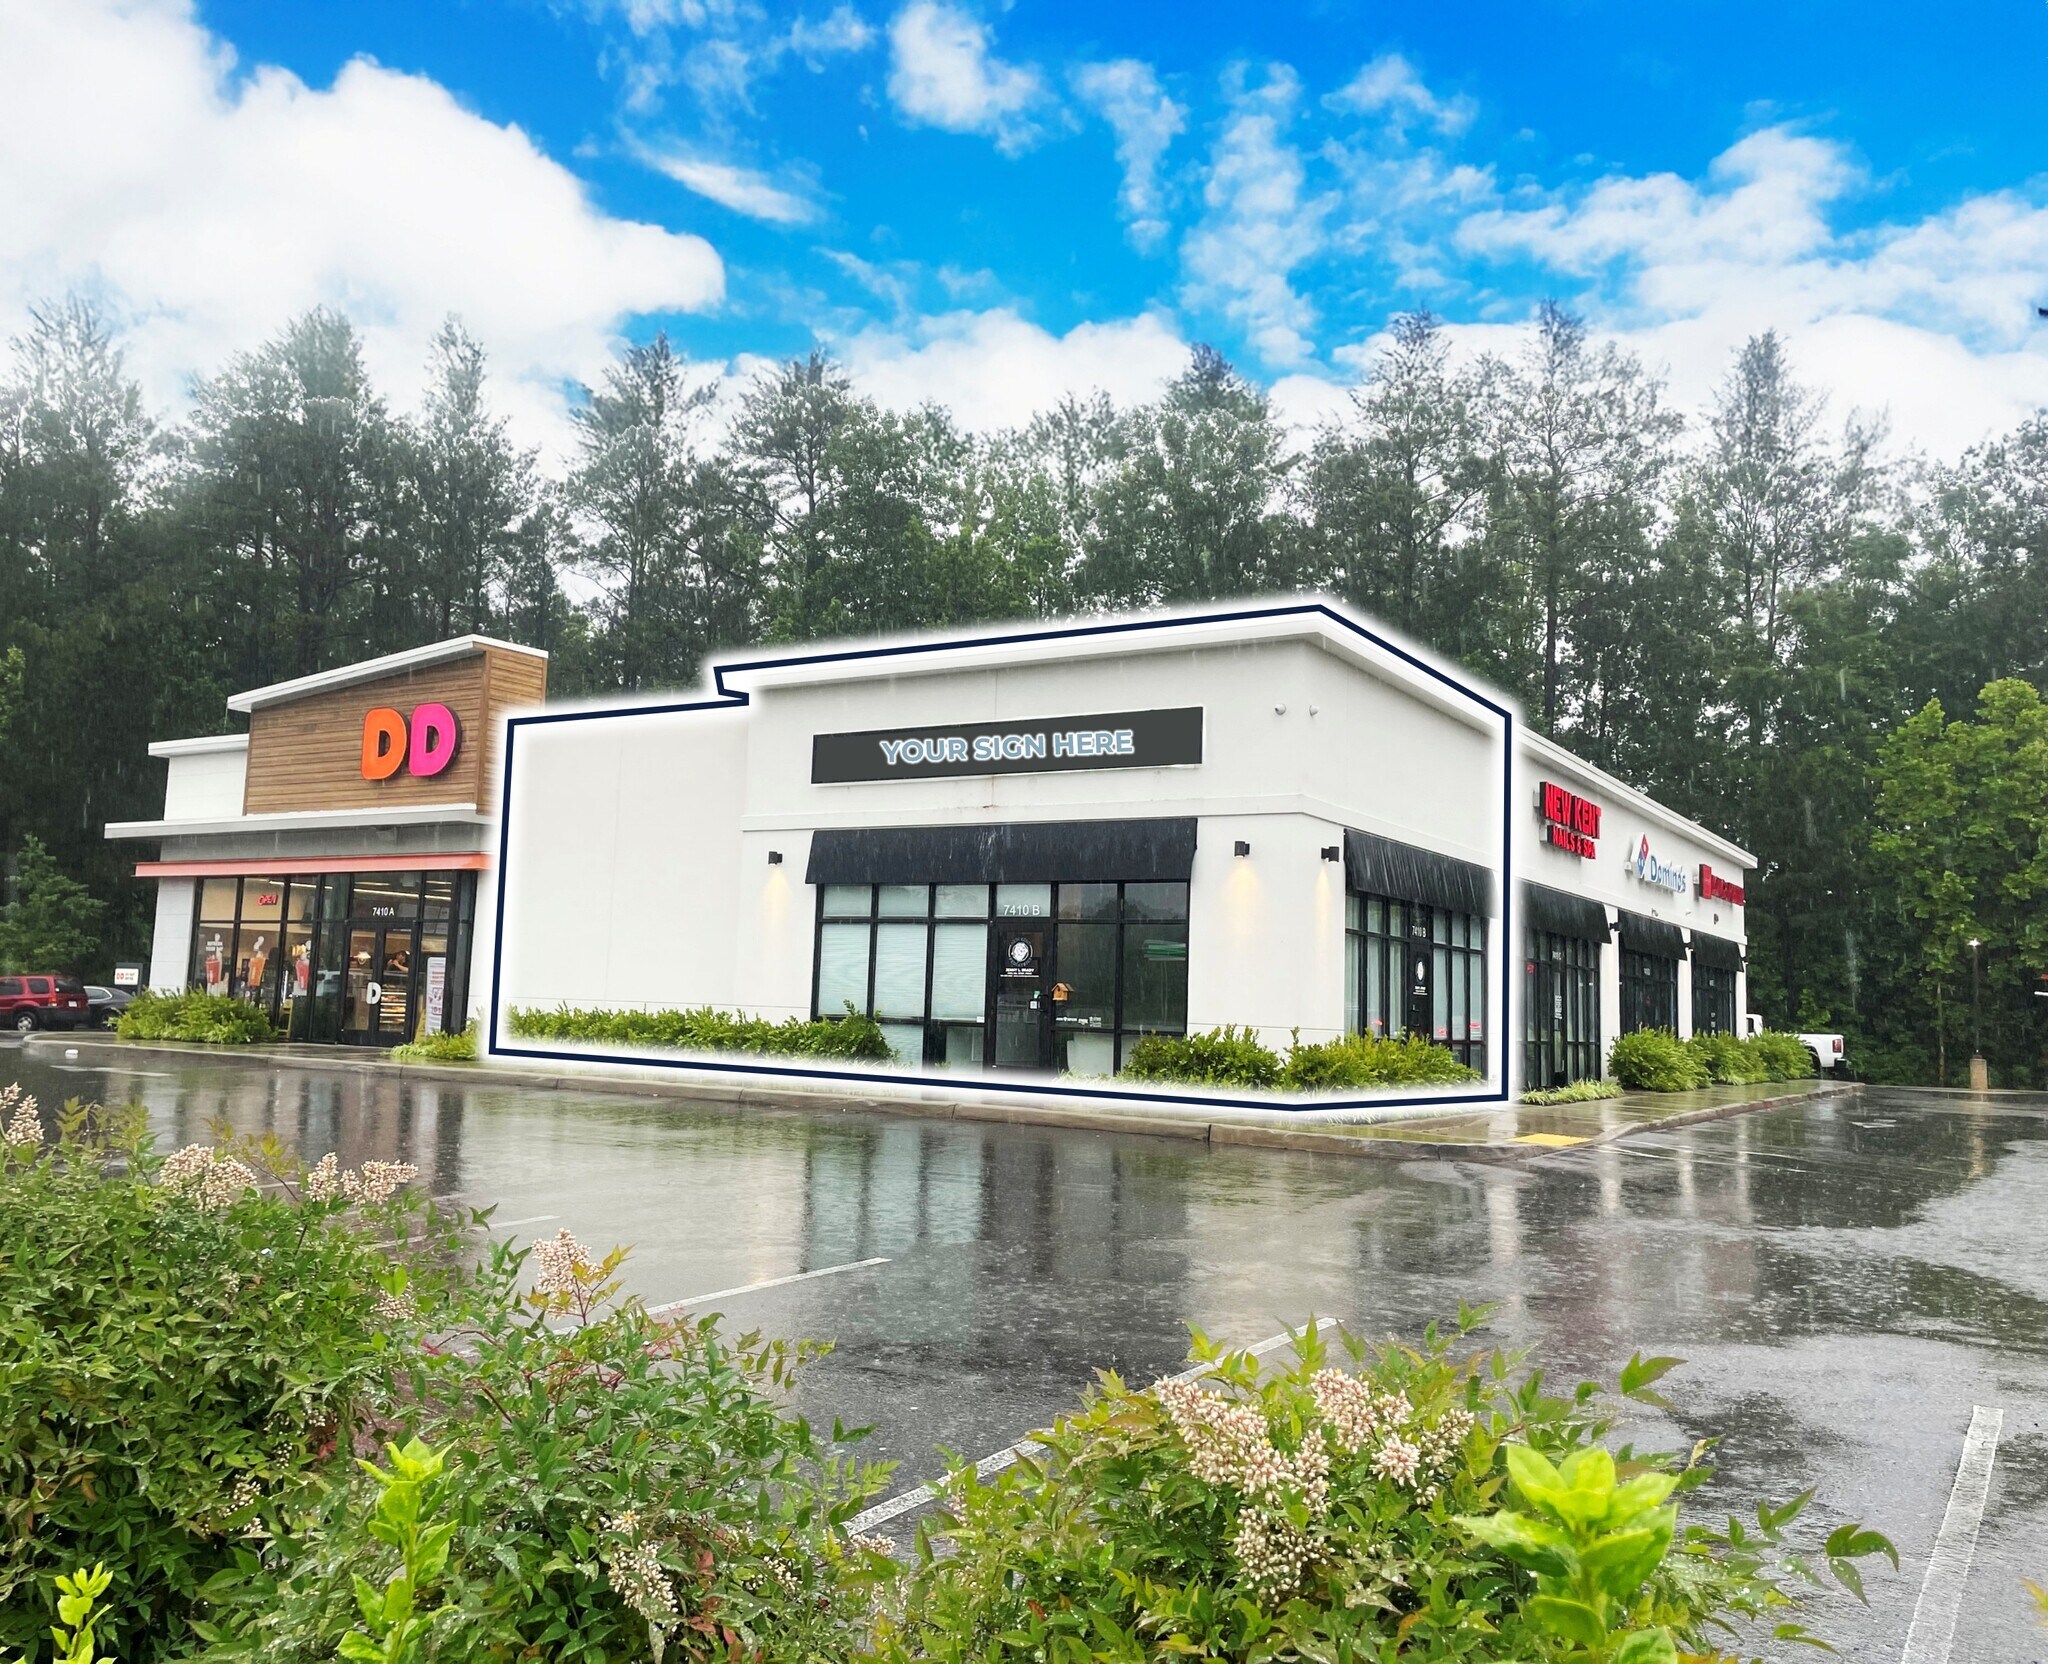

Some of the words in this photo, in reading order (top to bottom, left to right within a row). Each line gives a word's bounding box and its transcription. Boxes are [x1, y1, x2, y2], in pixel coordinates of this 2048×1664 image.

[361, 702, 460, 780] DD
[1543, 782, 1572, 827] NEW
[1573, 795, 1602, 840] KENT
[1551, 825, 1575, 852] NAILS
[1576, 836, 1582, 854] &
[1583, 838, 1597, 860] SPA
[1650, 855, 1687, 893] Domino's
[257, 893, 278, 906] OPEN
[372, 906, 389, 917] 7410
[389, 907, 395, 917] A
[1004, 905, 1029, 915] 7410
[1032, 905, 1040, 915] B
[366, 982, 382, 1005] D
